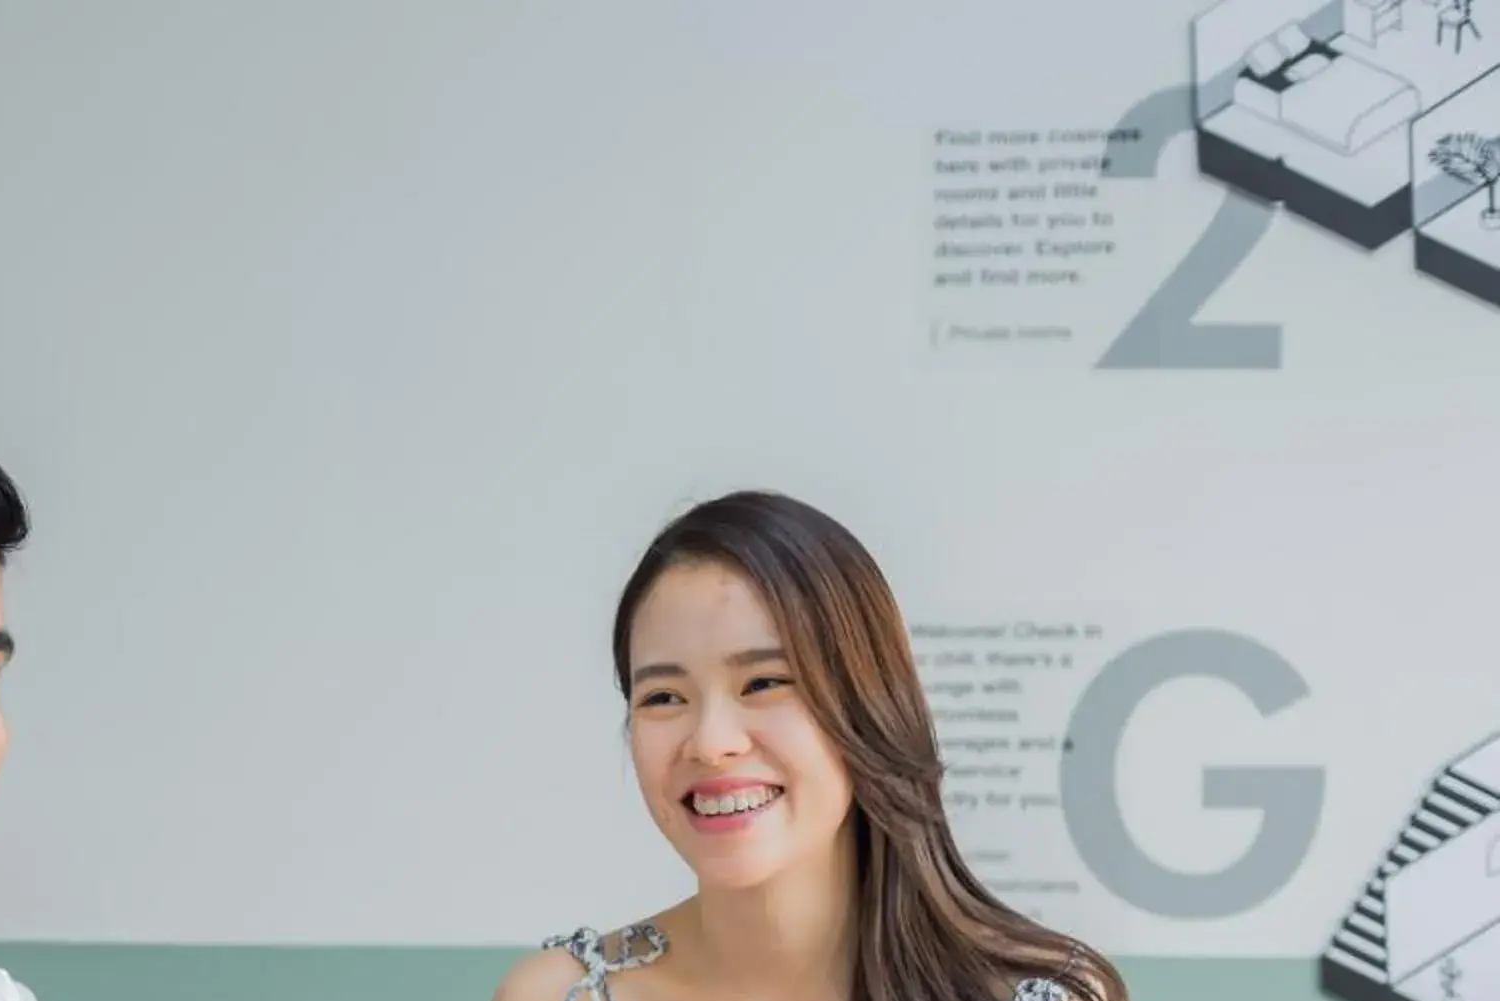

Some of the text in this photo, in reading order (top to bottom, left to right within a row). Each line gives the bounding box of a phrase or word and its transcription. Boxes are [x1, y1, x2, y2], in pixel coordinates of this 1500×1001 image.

[933, 129, 981, 145] Find
[986, 131, 1039, 145] more
[933, 155, 1112, 175] here with private
[933, 181, 1098, 202] rooms and little
[933, 211, 1114, 231] details for you to
[1035, 238, 1117, 259] Explore
[933, 268, 972, 287] and
[980, 267, 1020, 286] find
[1013, 622, 1077, 640] Check
[982, 677, 1021, 695] with
[1019, 733, 1056, 752] and
[1060, 627, 1326, 921] G
